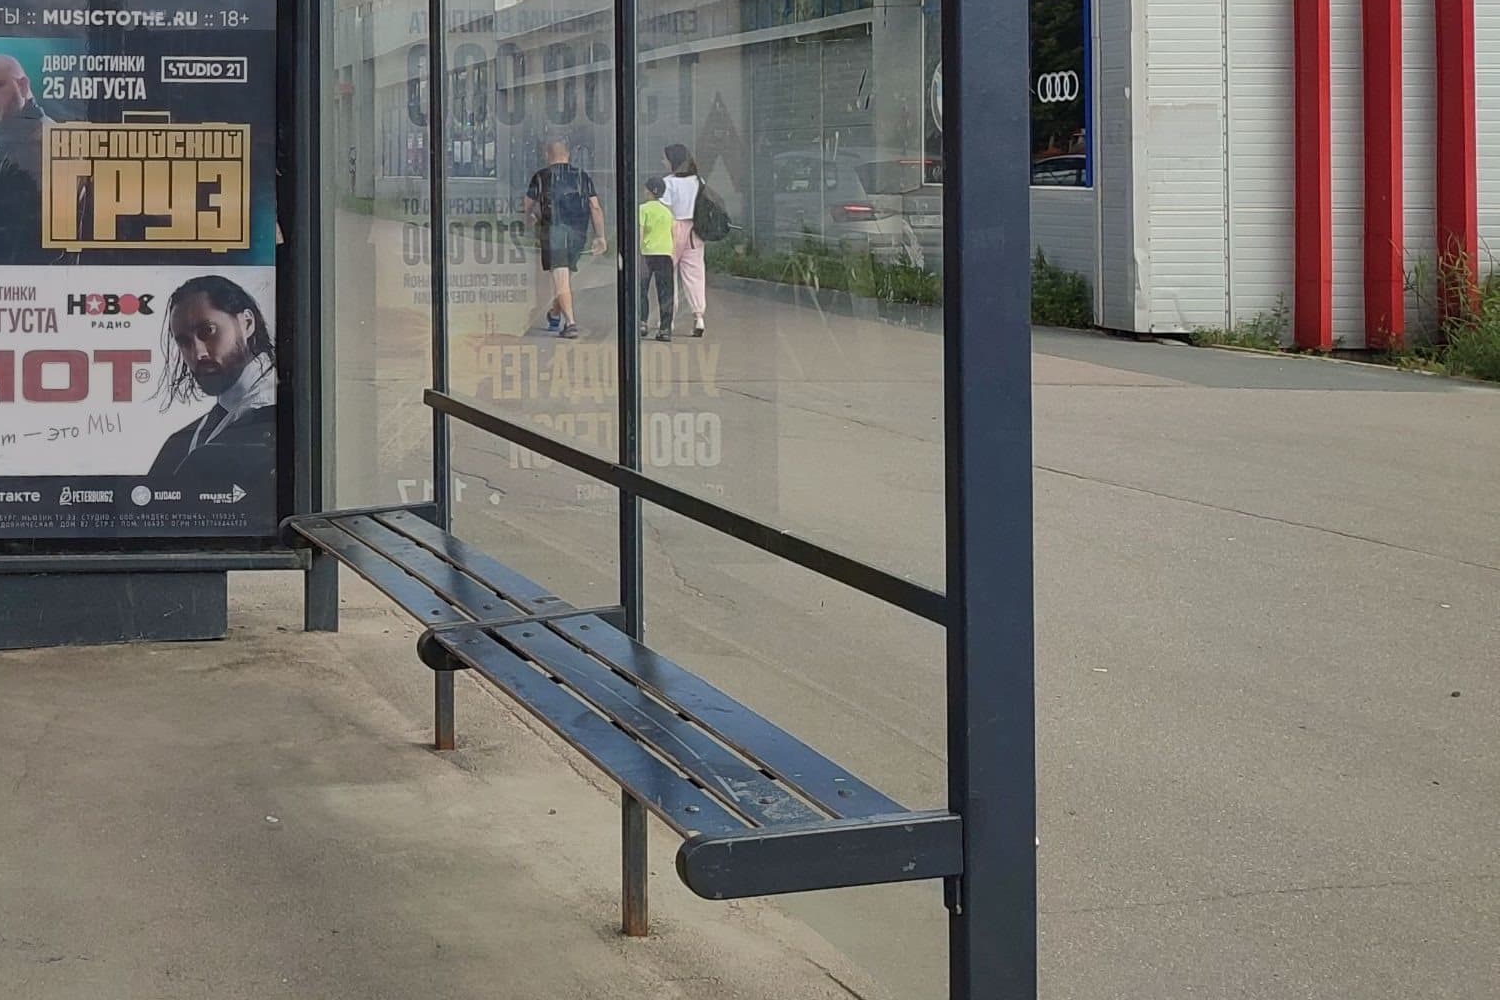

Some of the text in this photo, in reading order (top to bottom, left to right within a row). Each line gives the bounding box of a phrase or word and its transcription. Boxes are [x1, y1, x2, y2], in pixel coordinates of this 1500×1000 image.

[43, 10, 198, 27] MUSICTOTHE.RU
[219, 10, 250, 27] 18+
[42, 54, 145, 74] ДВОР ГОСТИНКИ
[167, 62, 242, 78] STUDIO 21
[42, 76, 147, 100] 25 АВГУСТА
[51, 129, 243, 159] КАСПИЙСКИЙ
[51, 159, 244, 242] ГРУЗ
[90, 320, 132, 330] РАДИО
[47, 425, 80, 442] это
